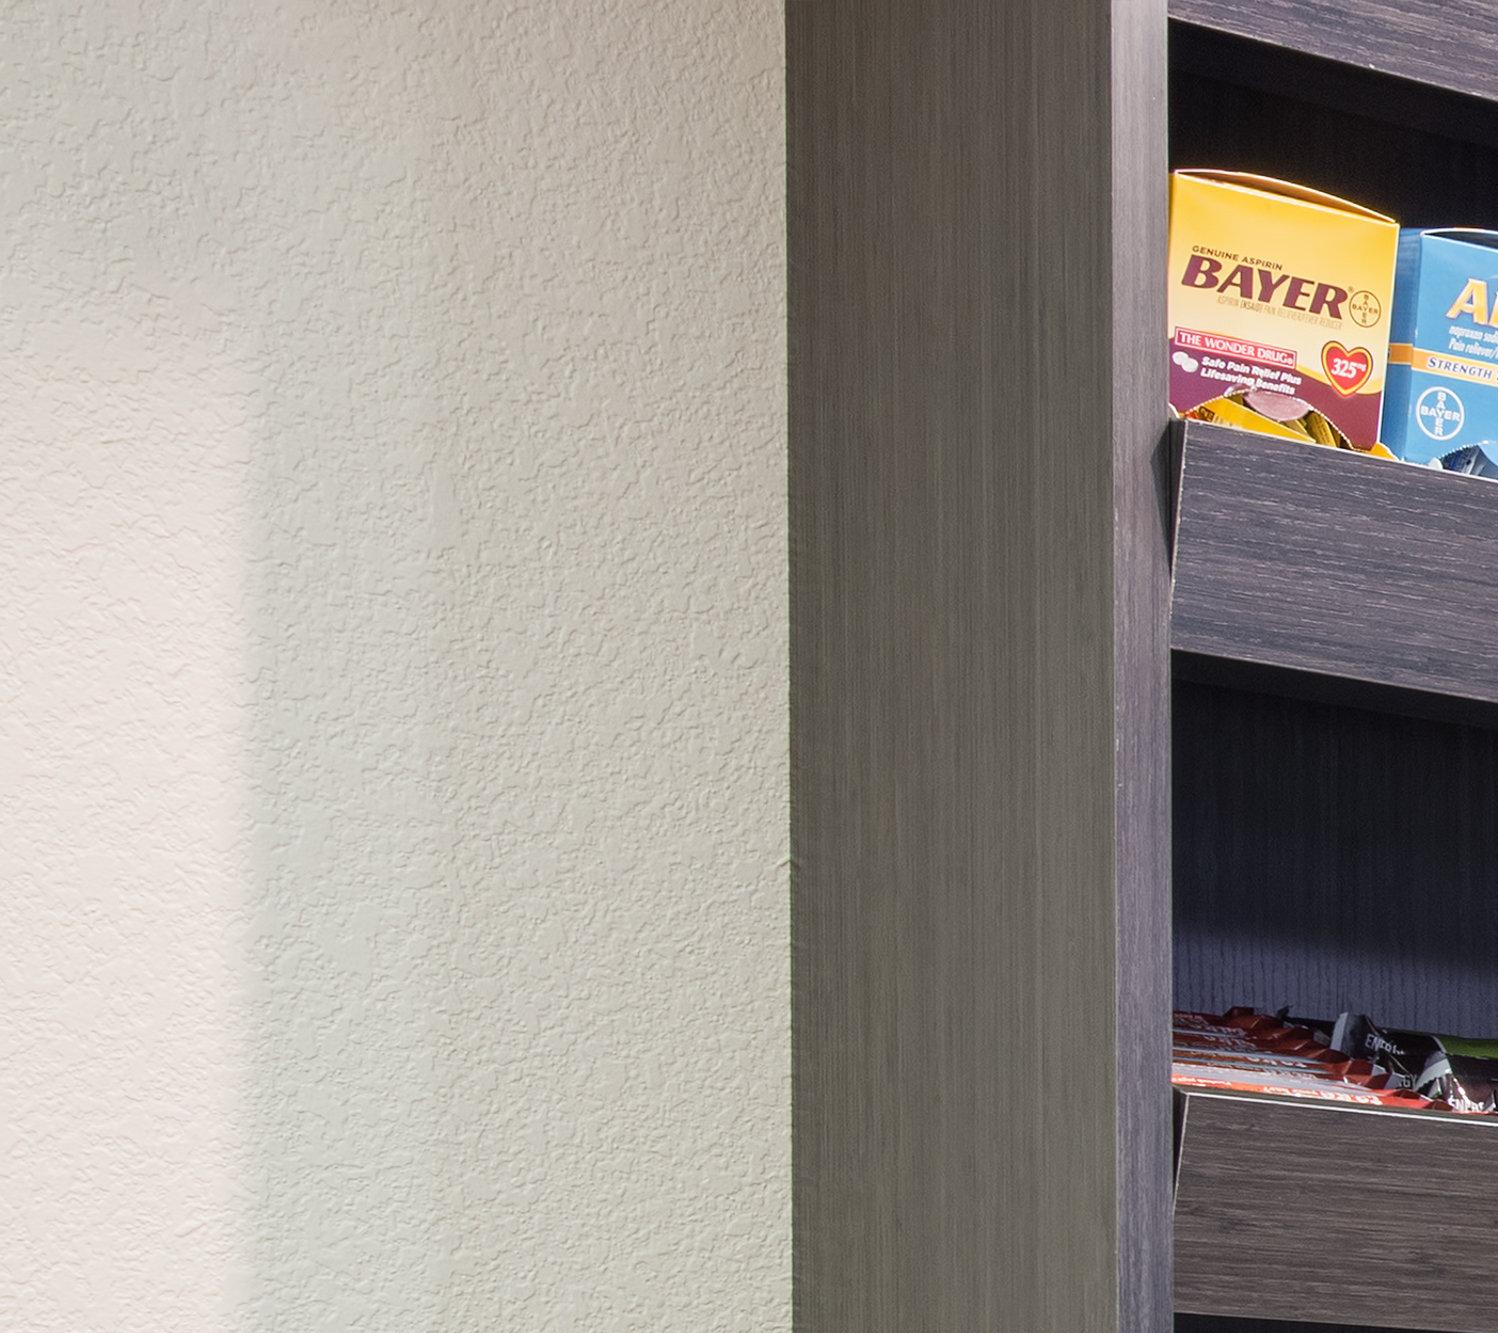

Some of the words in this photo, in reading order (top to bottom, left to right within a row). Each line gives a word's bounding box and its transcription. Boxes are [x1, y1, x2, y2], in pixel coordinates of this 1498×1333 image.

[1191, 245, 1239, 262] GENUINE
[1241, 257, 1283, 271] ASPIRIN
[1181, 254, 1348, 320] BAYER
[1179, 332, 1202, 346] THE
[1203, 337, 1255, 357] WONDER
[1428, 358, 1492, 379] STRENGTH
